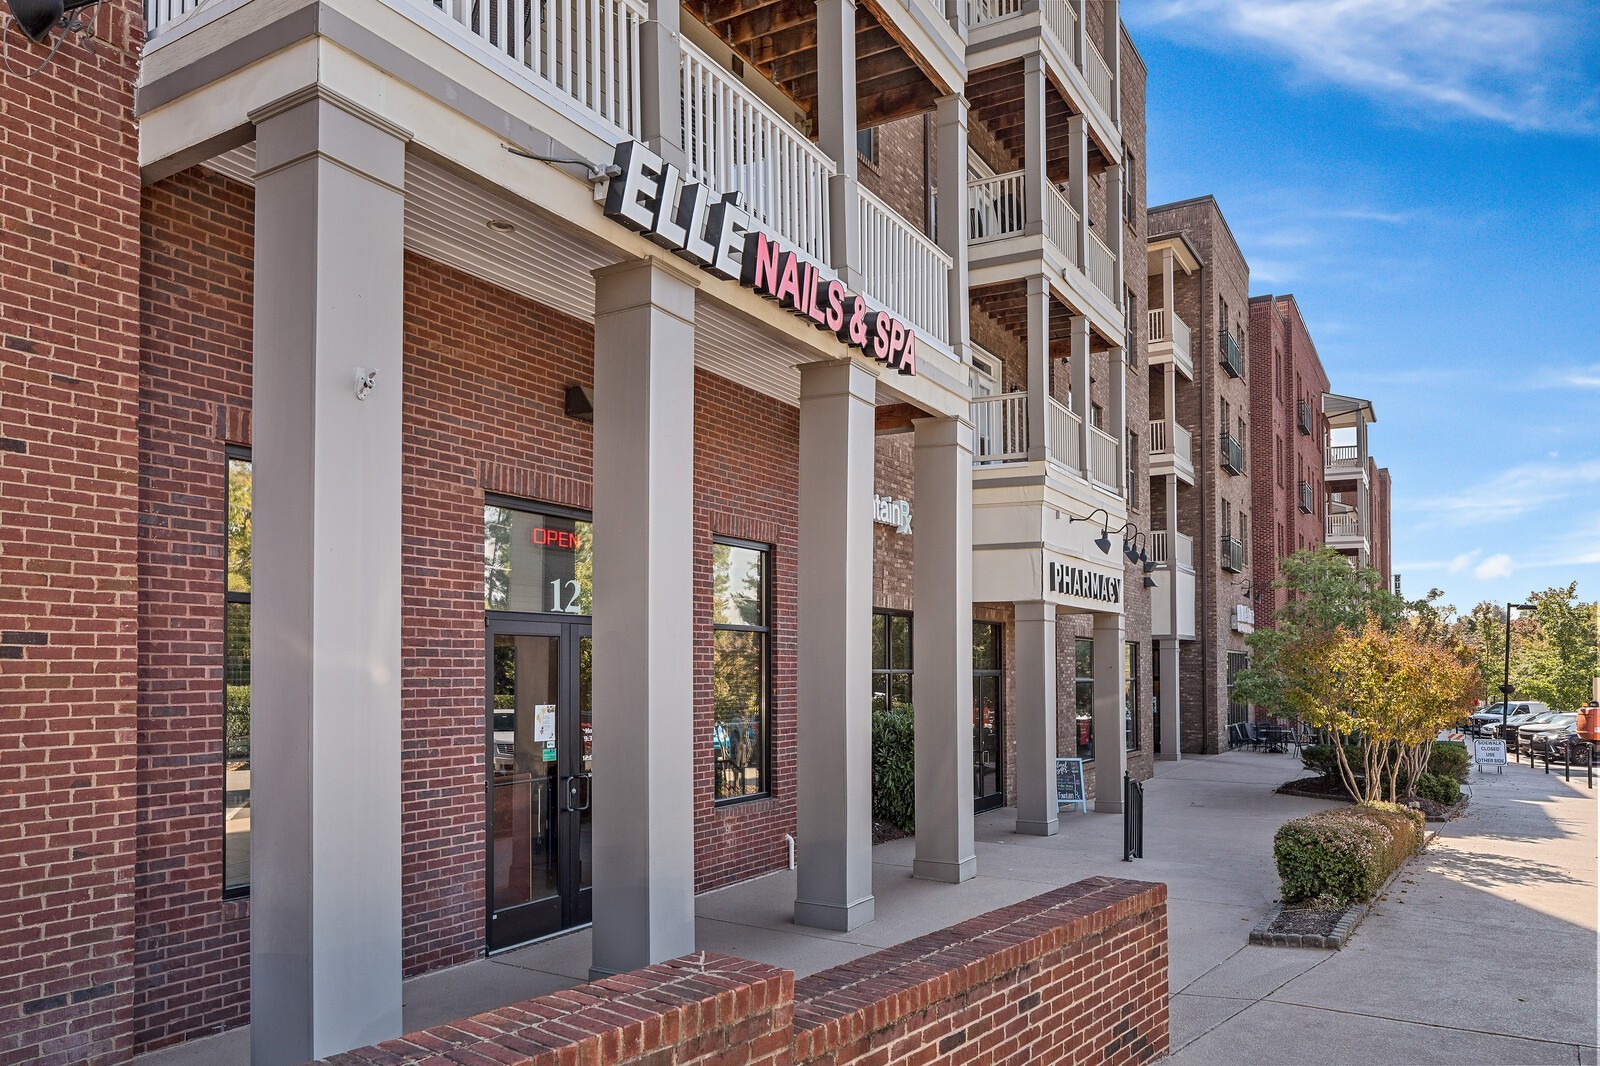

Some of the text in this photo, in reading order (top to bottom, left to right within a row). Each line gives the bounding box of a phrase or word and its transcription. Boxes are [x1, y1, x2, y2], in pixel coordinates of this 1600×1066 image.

[745, 231, 846, 333] NAILS
[845, 295, 868, 348] &
[868, 311, 916, 376] SPA
[533, 528, 581, 550] OPEN
[550, 578, 581, 614] 12
[1050, 562, 1121, 603] PHARMACY
